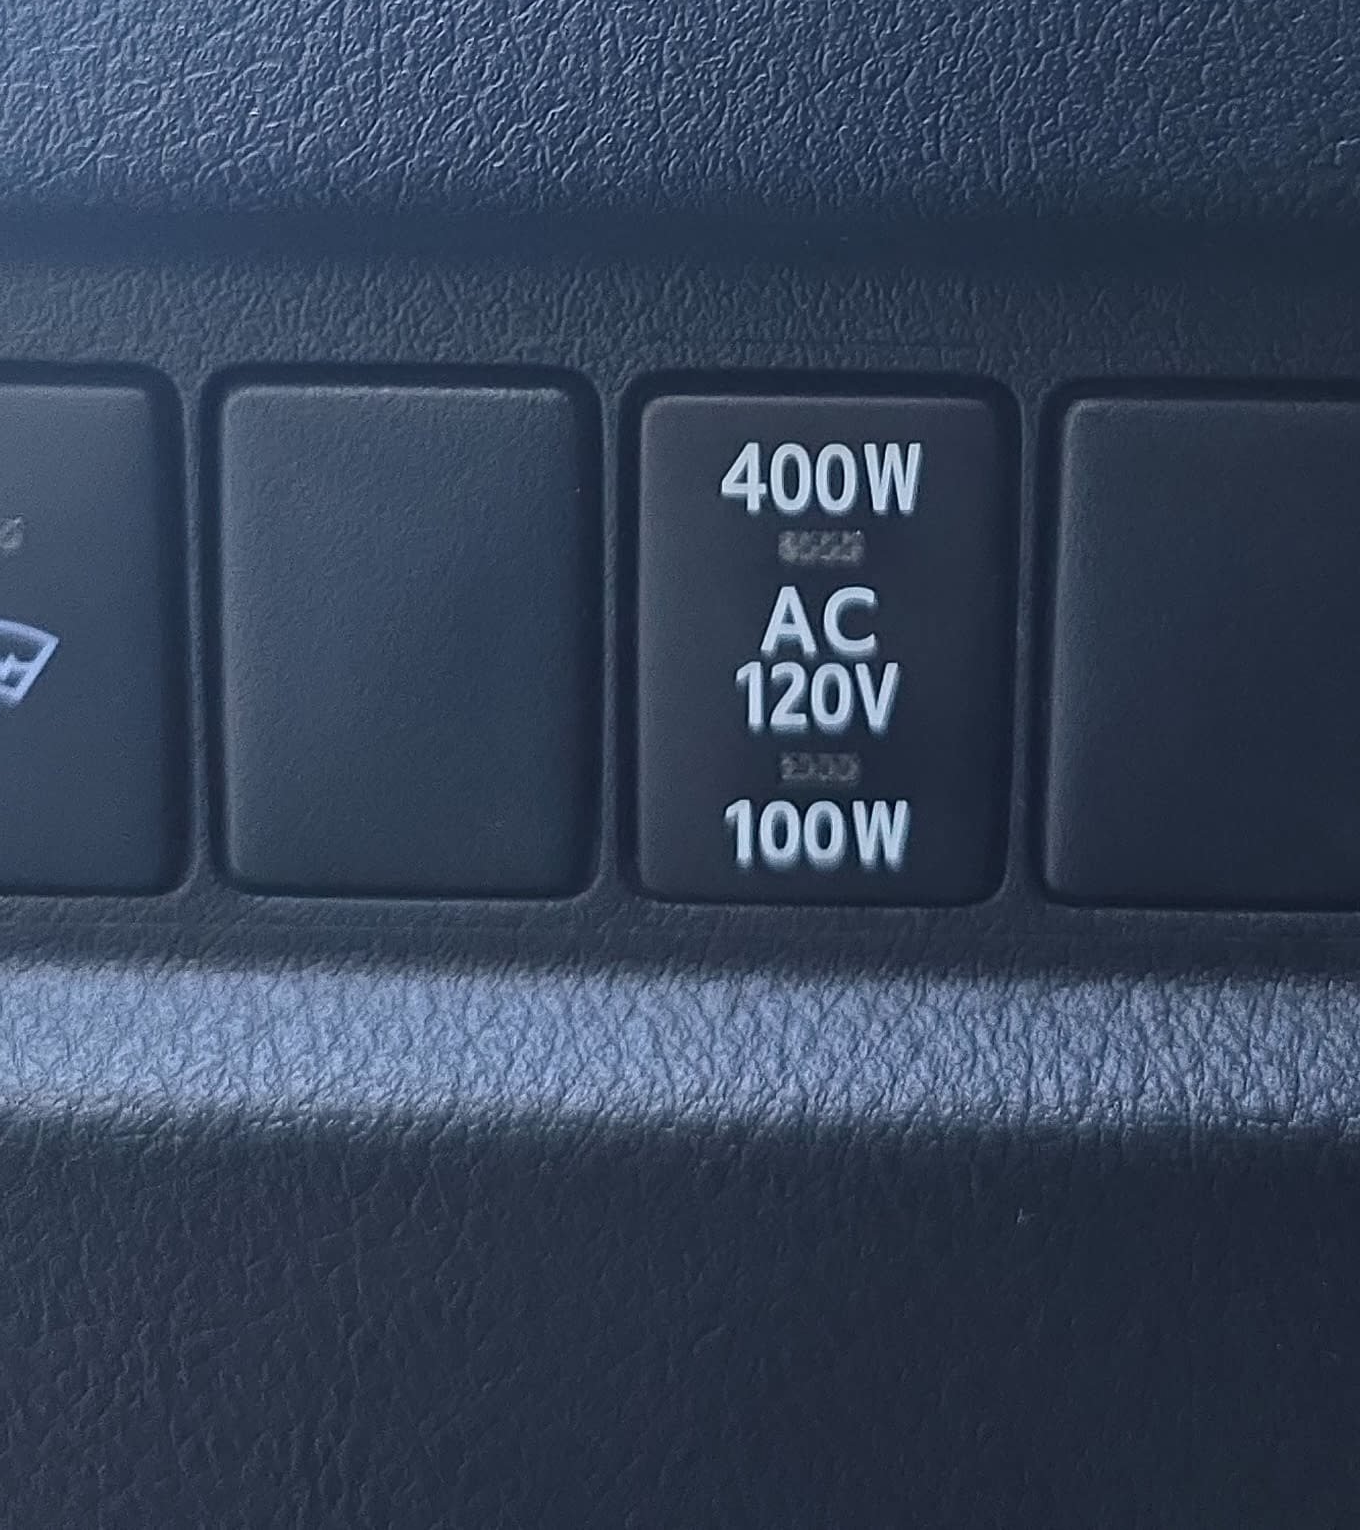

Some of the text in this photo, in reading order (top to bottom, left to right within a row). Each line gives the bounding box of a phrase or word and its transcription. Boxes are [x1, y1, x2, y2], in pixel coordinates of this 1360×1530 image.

[720, 441, 923, 514] 400W
[759, 584, 878, 658] AC
[735, 660, 901, 732] 120V
[724, 798, 910, 867] 100W
